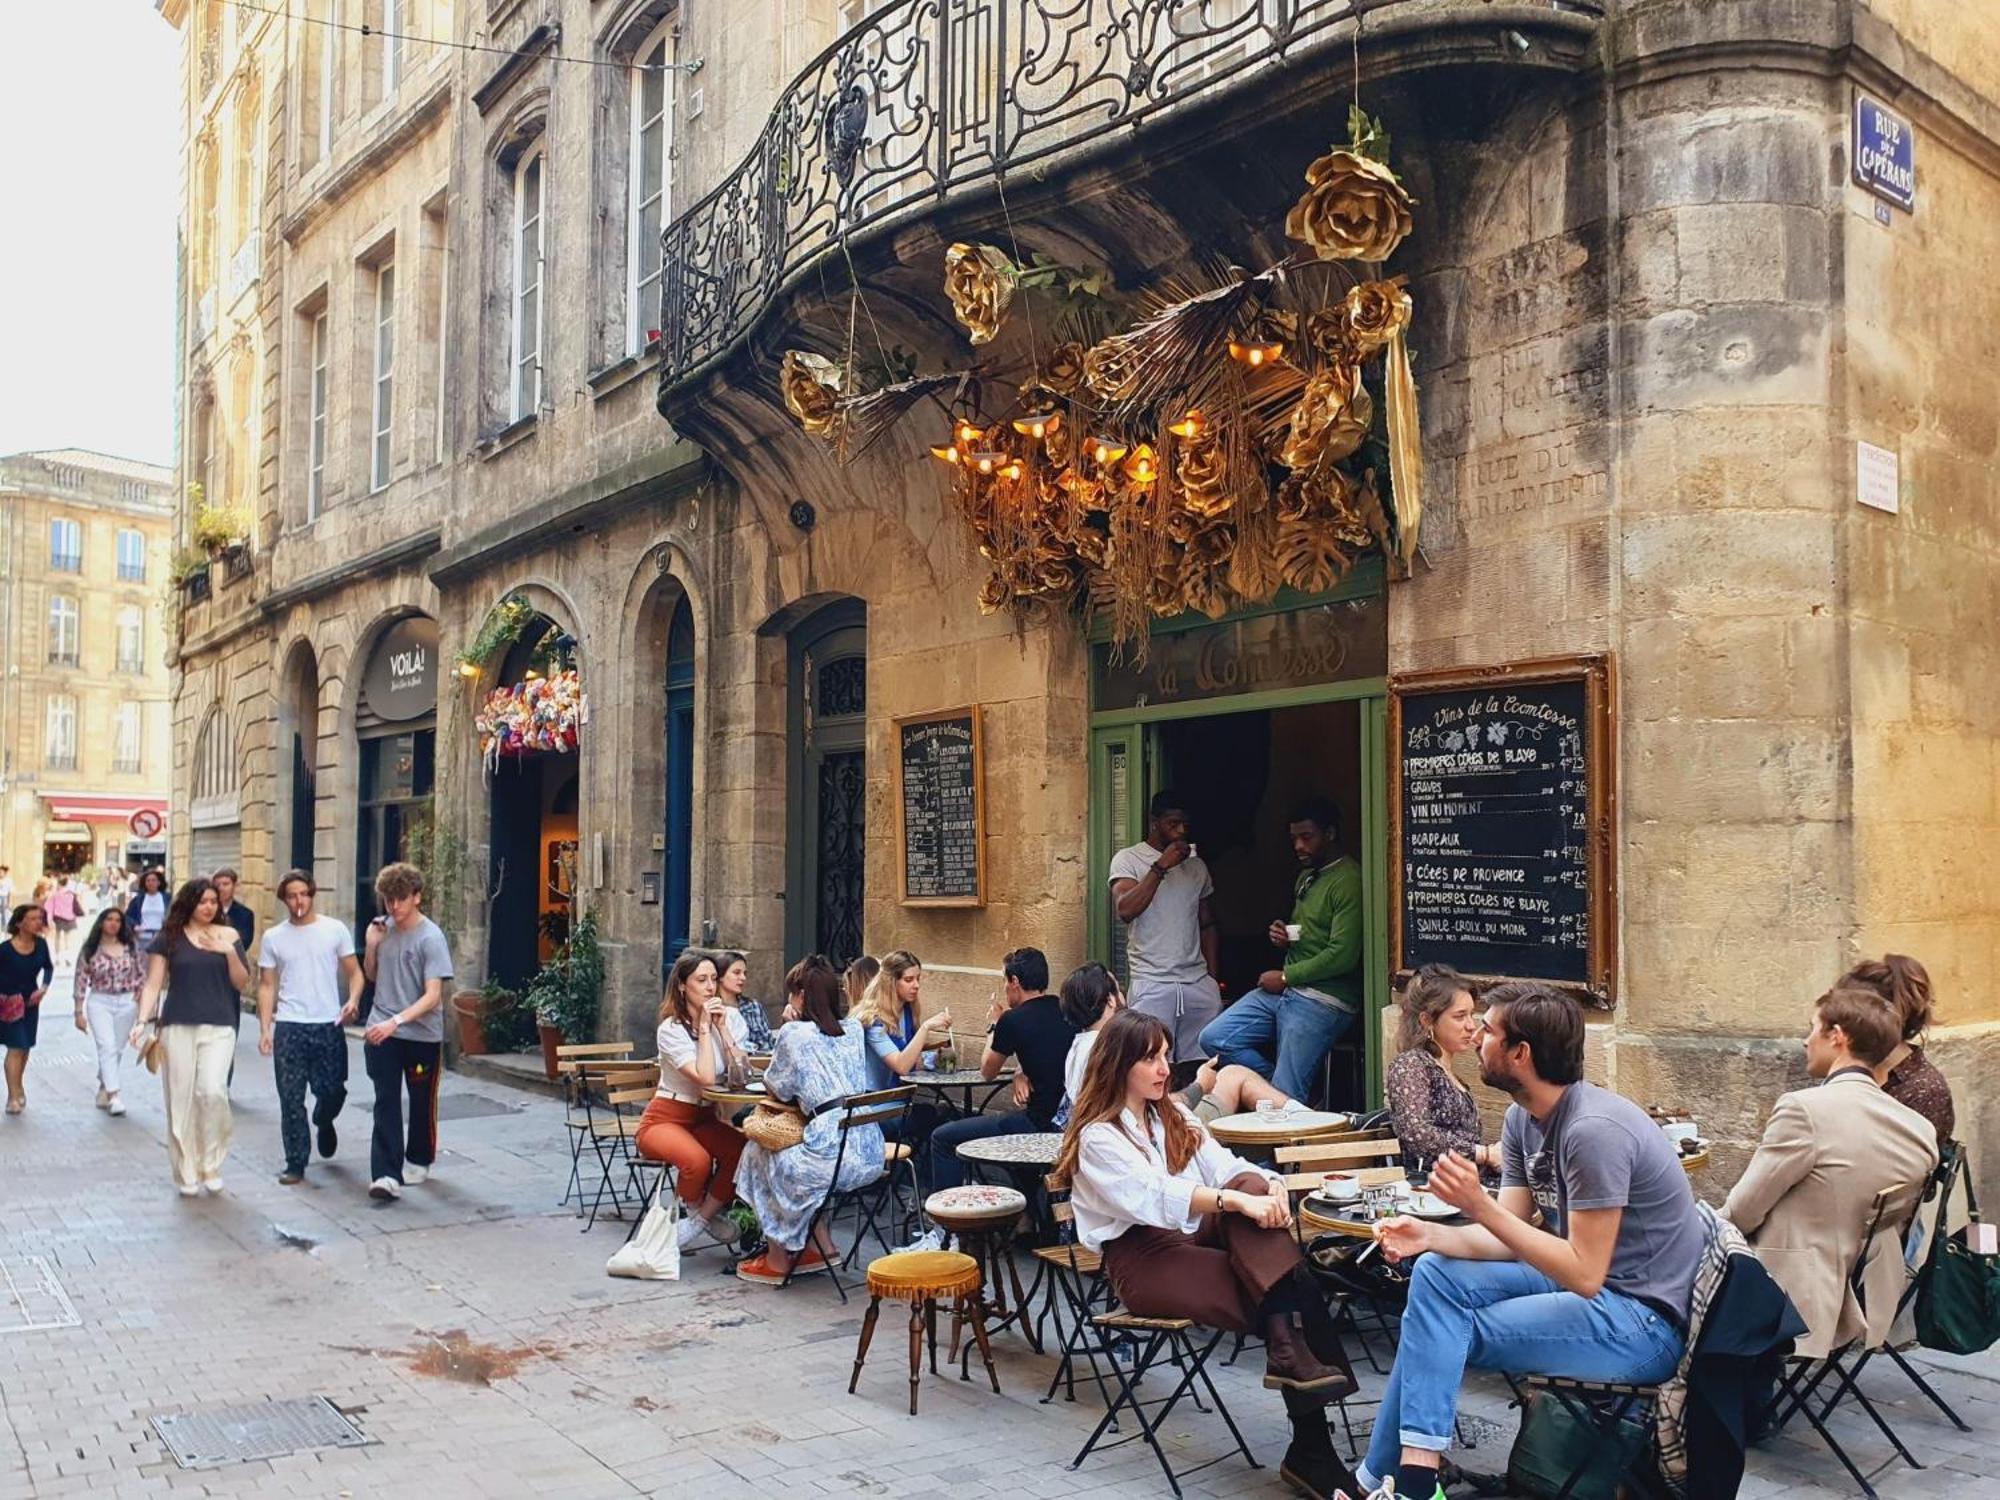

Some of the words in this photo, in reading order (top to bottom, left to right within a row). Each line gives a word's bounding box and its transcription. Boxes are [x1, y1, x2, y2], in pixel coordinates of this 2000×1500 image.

[1875, 111, 1900, 145] RUE
[1536, 441, 1573, 474] DU
[1434, 706, 1464, 728] Vins
[1467, 697, 1482, 716] de
[1485, 695, 1499, 713] la
[1487, 751, 1500, 764] DE
[1411, 803, 1429, 818] VIN
[1430, 802, 1442, 817] DU
[1453, 867, 1467, 882] DE
[1472, 867, 1525, 883] PROVENCE
[1503, 896, 1515, 909] DE
